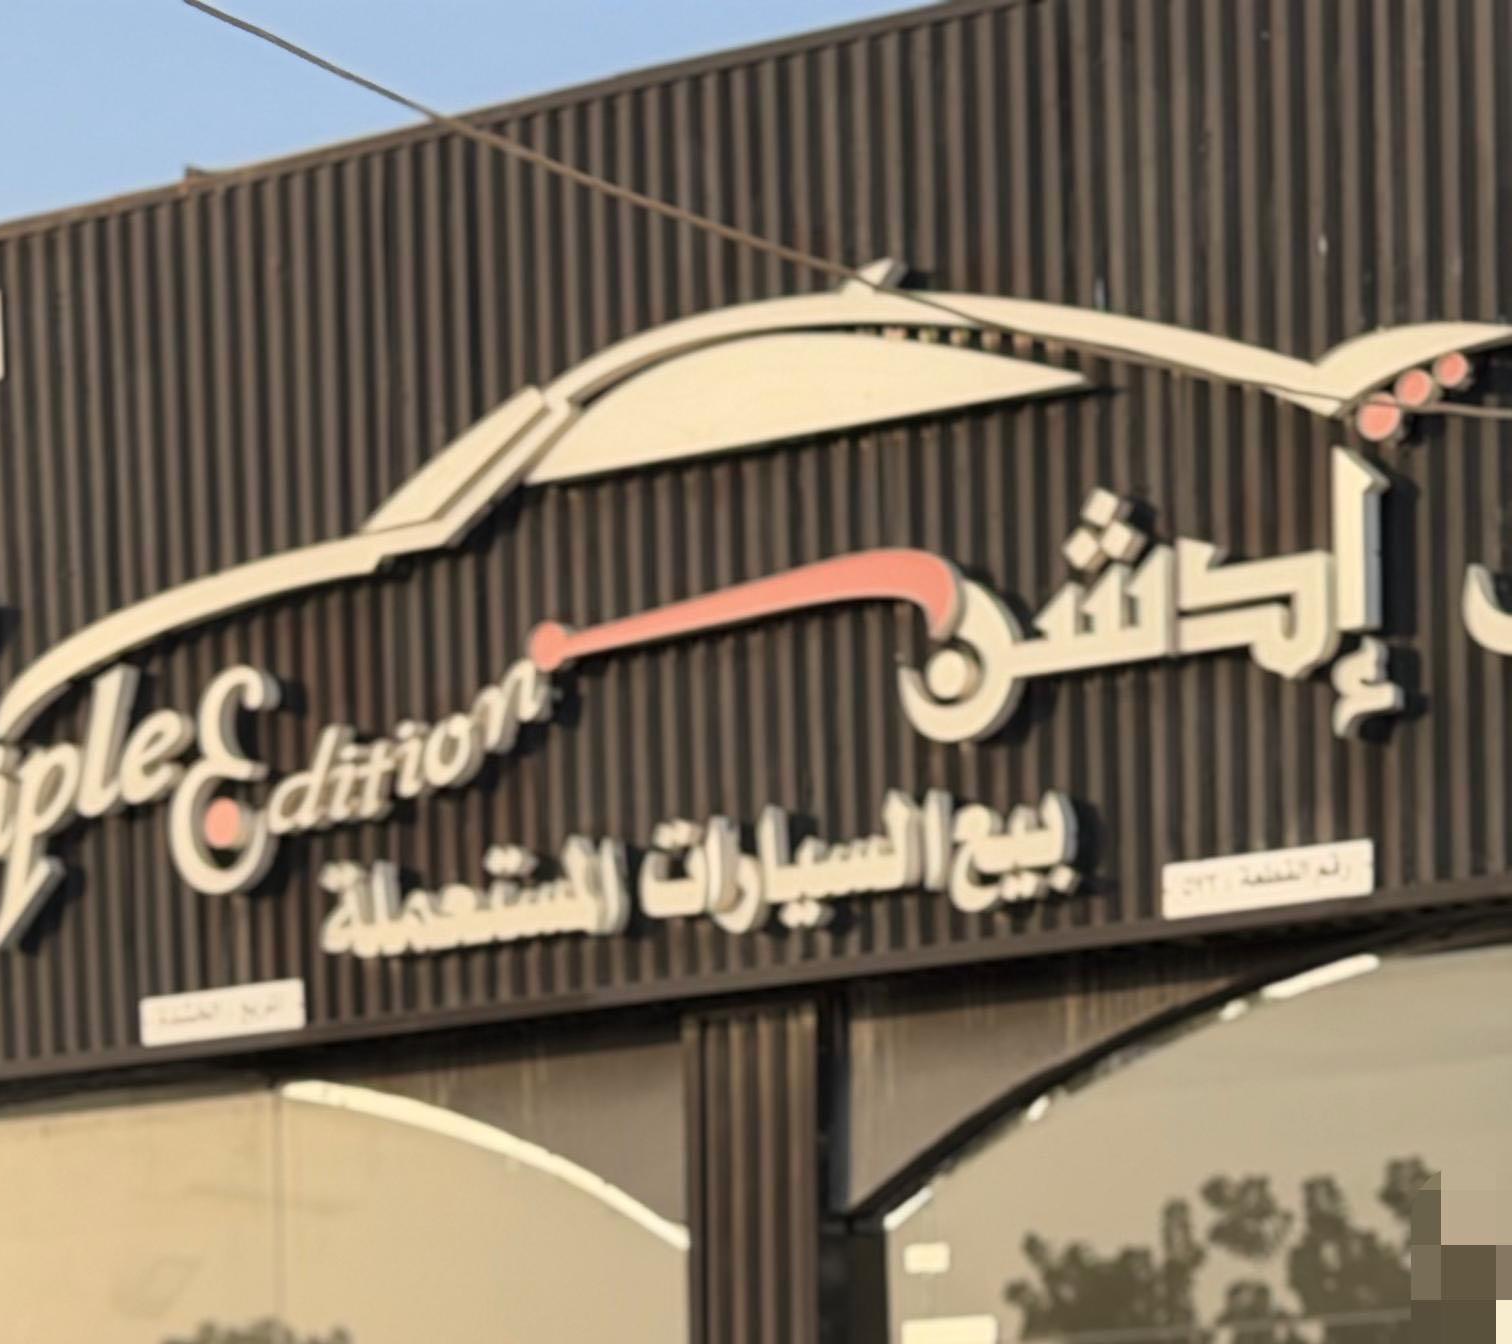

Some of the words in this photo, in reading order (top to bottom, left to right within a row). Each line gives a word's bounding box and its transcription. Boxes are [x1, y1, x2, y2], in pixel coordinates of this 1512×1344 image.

[168, 664, 554, 895] Edition
[319, 833, 630, 958] المستعملة
[639, 787, 951, 934] السيارات
[947, 789, 1076, 912] بيع
